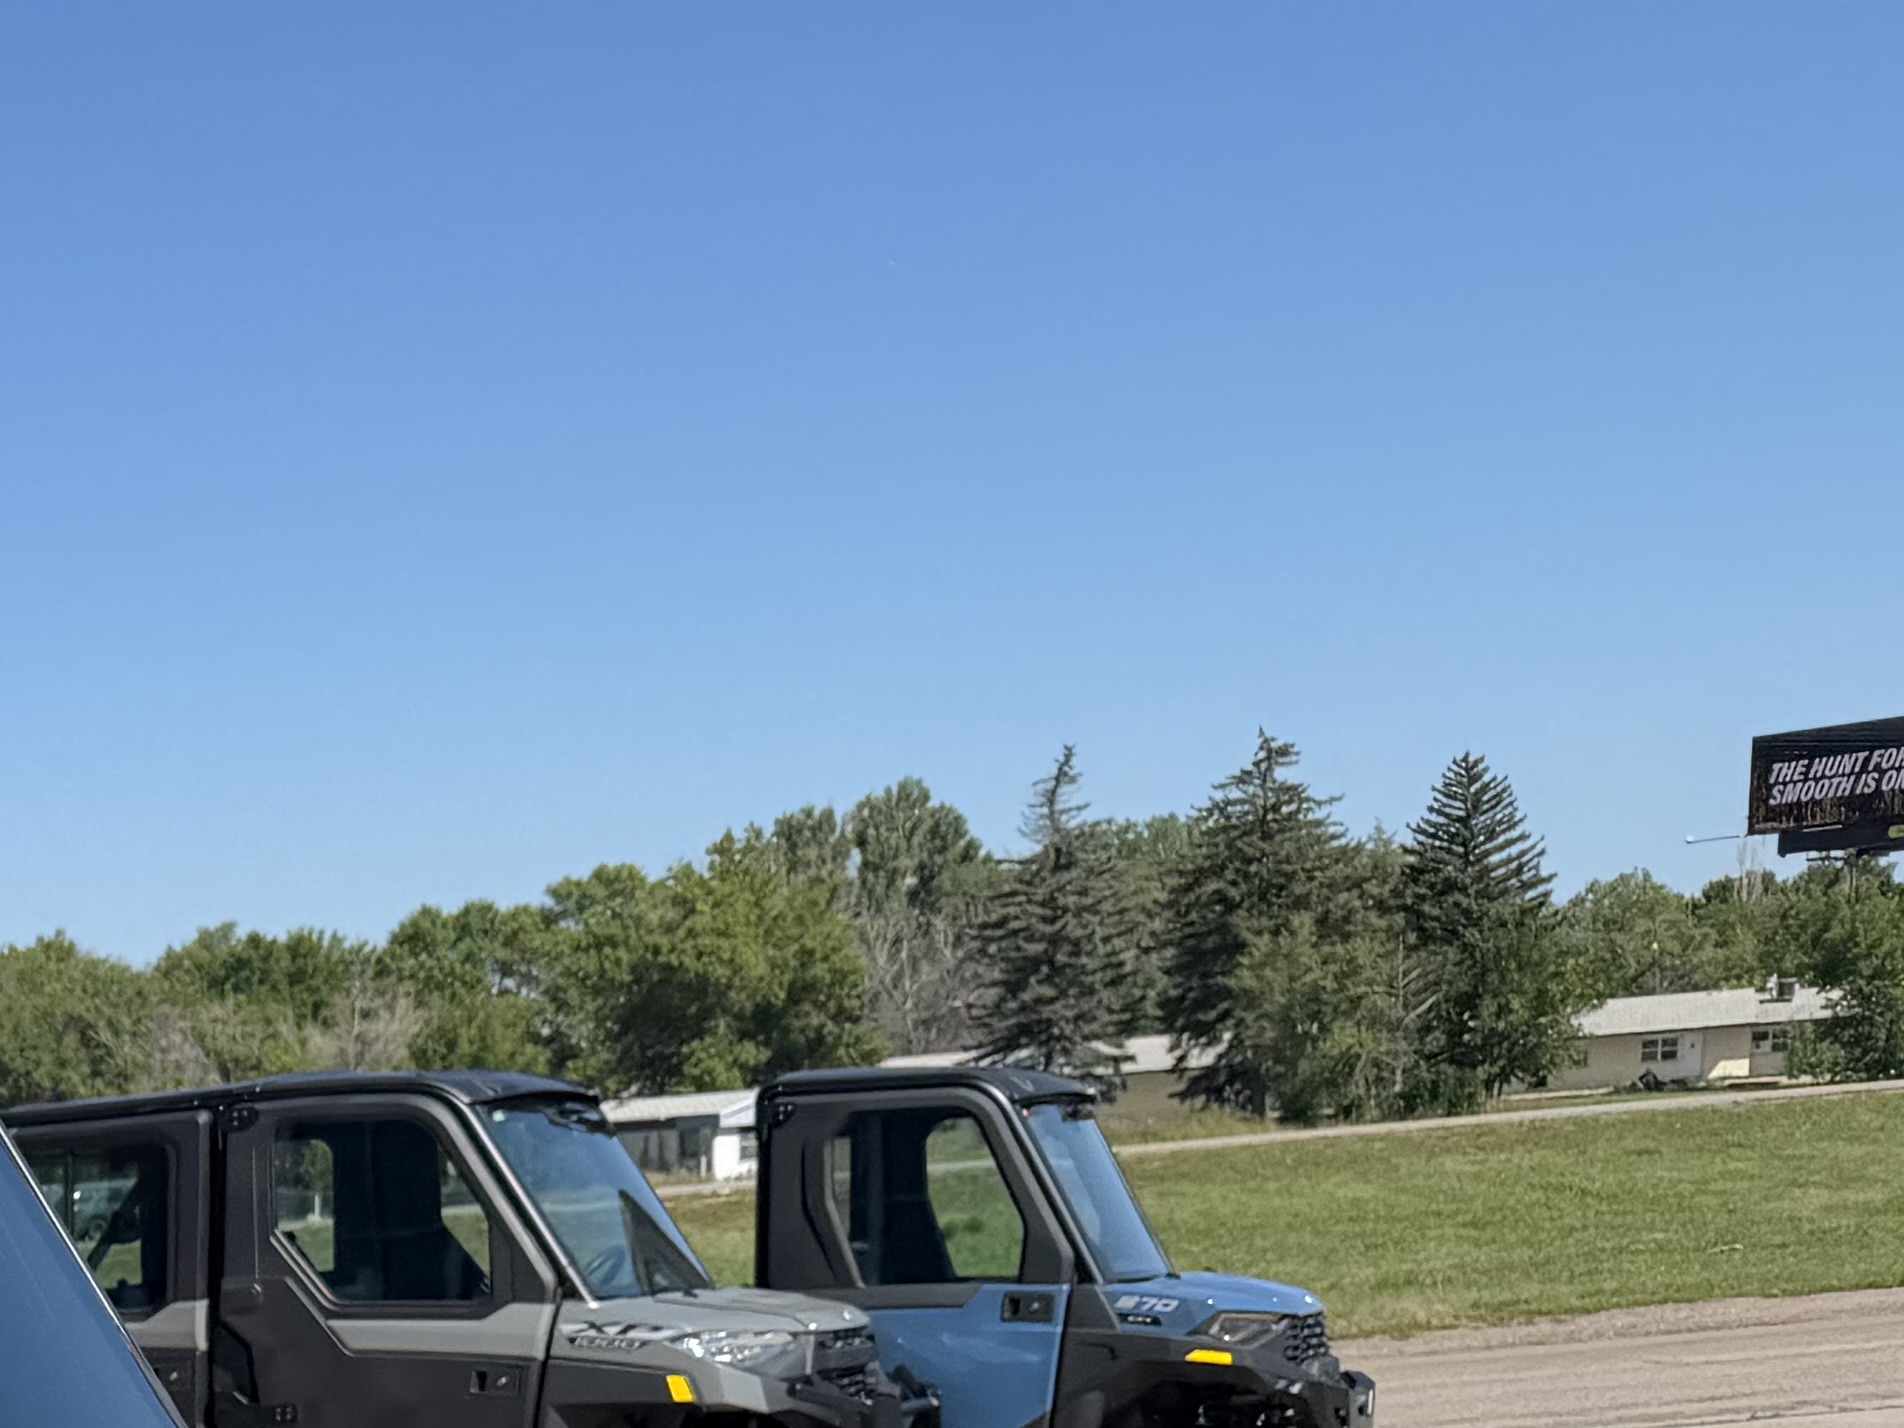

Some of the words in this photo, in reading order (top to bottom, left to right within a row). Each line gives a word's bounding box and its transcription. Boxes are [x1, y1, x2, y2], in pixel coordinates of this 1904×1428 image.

[1769, 760, 1809, 785] THE
[1808, 751, 1870, 779] HUNT
[1768, 775, 1855, 806] SMOOTH
[1855, 772, 1879, 795] IS
